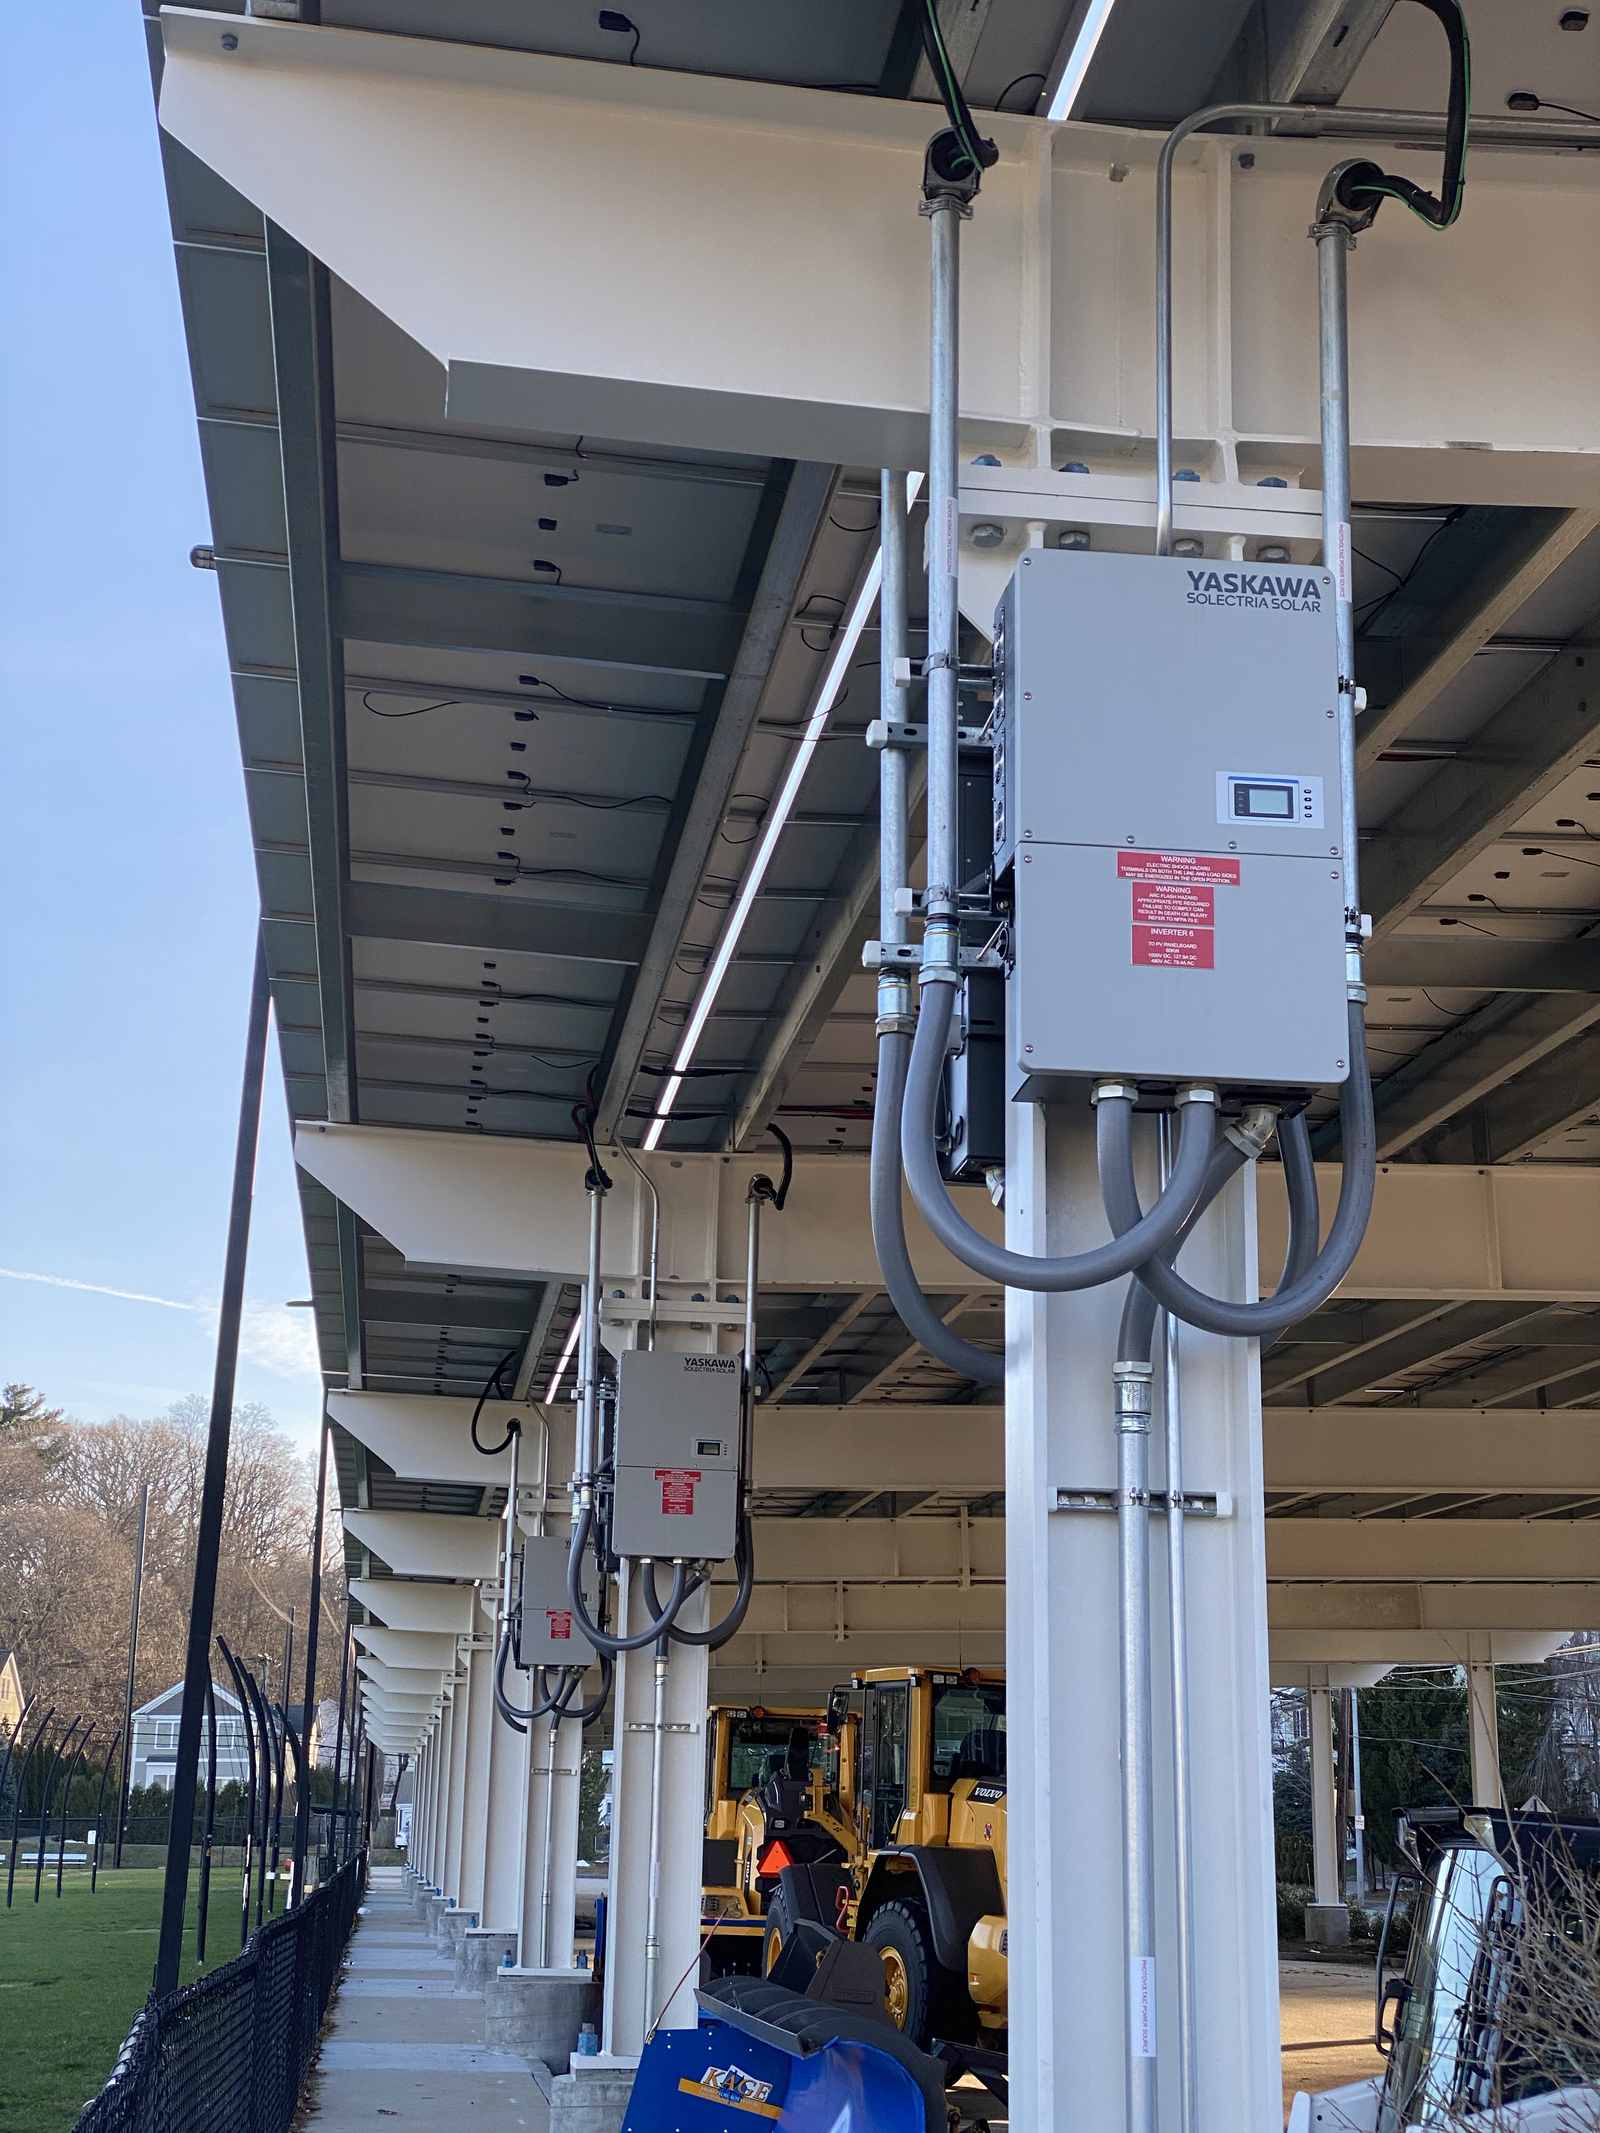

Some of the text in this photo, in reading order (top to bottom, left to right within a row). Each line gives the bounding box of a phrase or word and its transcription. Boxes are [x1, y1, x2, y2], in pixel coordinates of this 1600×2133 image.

[1187, 570, 1320, 598] YASKAWA
[1187, 592, 1320, 612] SOLECTRIA SOLAR
[1161, 855, 1196, 863] WARNING
[684, 1357, 735, 1368] YASKAWA
[974, 1787, 1003, 1799] VOLVO
[703, 2068, 772, 2101] KAGE
